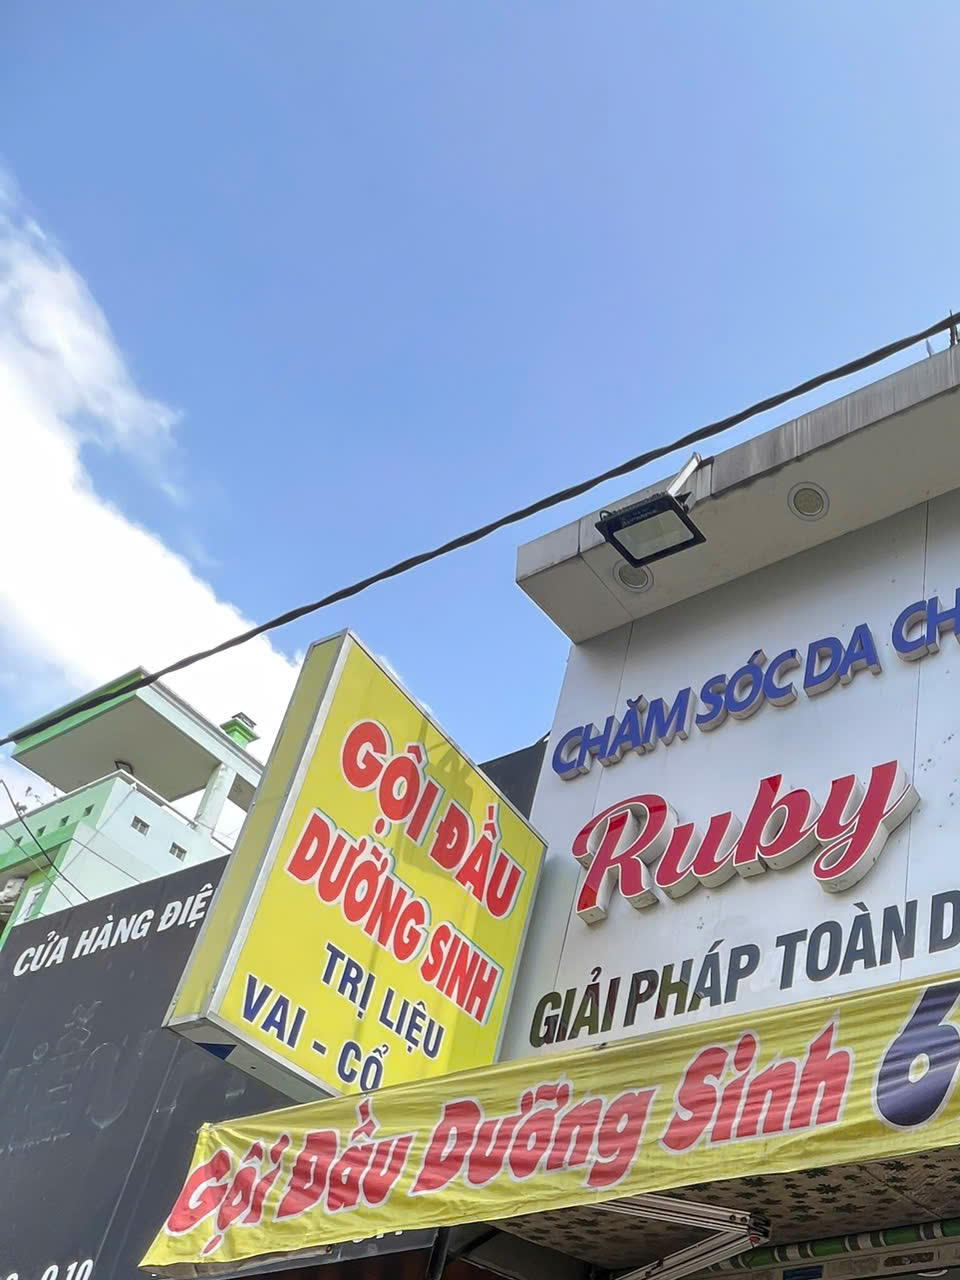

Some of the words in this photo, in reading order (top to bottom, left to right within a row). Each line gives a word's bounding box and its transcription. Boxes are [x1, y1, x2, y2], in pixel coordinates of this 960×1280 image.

[552, 693, 703, 781] CHĂM
[697, 650, 801, 733] SÓC
[803, 623, 883, 697] DA
[340, 718, 431, 846] GỘI
[431, 804, 527, 921] ĐẦU
[572, 759, 921, 925] Ruby
[13, 930, 69, 977] CỬA
[72, 909, 154, 959] HÀNG
[285, 808, 426, 963] DƯỠNG
[421, 918, 505, 1027] SINH
[529, 966, 624, 1050] GIẢI
[623, 938, 760, 1028] PHÁP
[776, 902, 917, 990] TOÀN
[240, 973, 307, 1050] VAI
[337, 1041, 388, 1093] CỔ
[321, 942, 378, 1022] TRỊ
[378, 987, 445, 1061] LIỆU
[166, 1133, 289, 1257] Gội
[410, 1075, 660, 1196] Dưỡng
[659, 1012, 855, 1156] Sinh
